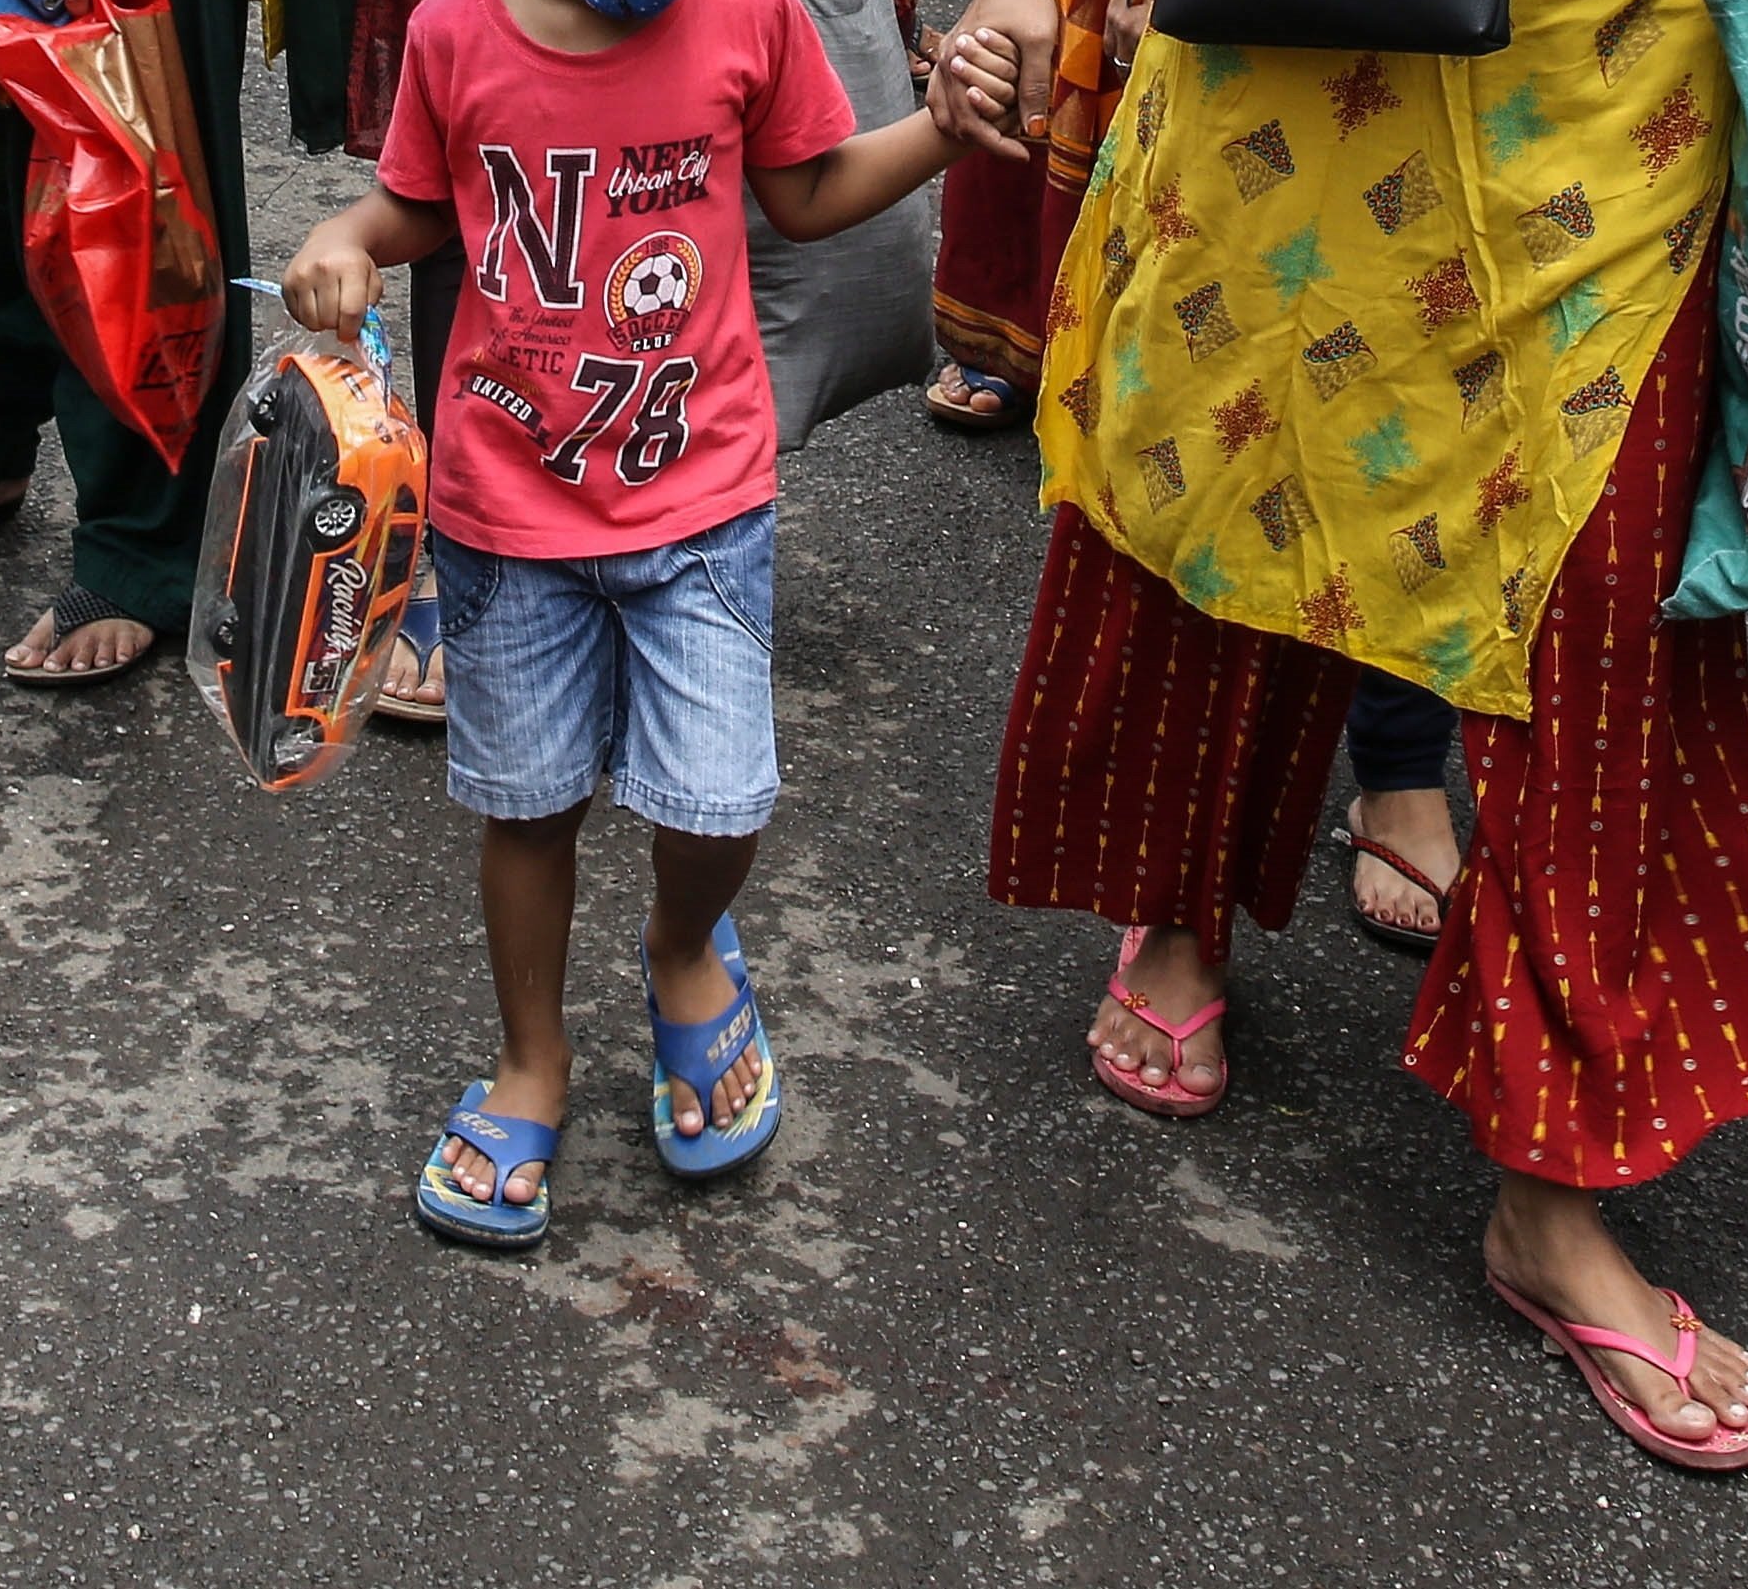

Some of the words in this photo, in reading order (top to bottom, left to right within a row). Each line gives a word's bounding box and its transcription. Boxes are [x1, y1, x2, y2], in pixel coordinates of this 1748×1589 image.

[608, 167, 673, 198] Urban
[677, 150, 712, 187] City
[620, 133, 713, 174] NEW
[476, 143, 597, 309] N
[604, 178, 709, 219] YORK
[472, 375, 533, 422] UNITED
[540, 352, 699, 487] 78
[324, 557, 368, 652] Racing
[707, 1000, 752, 1062] step
